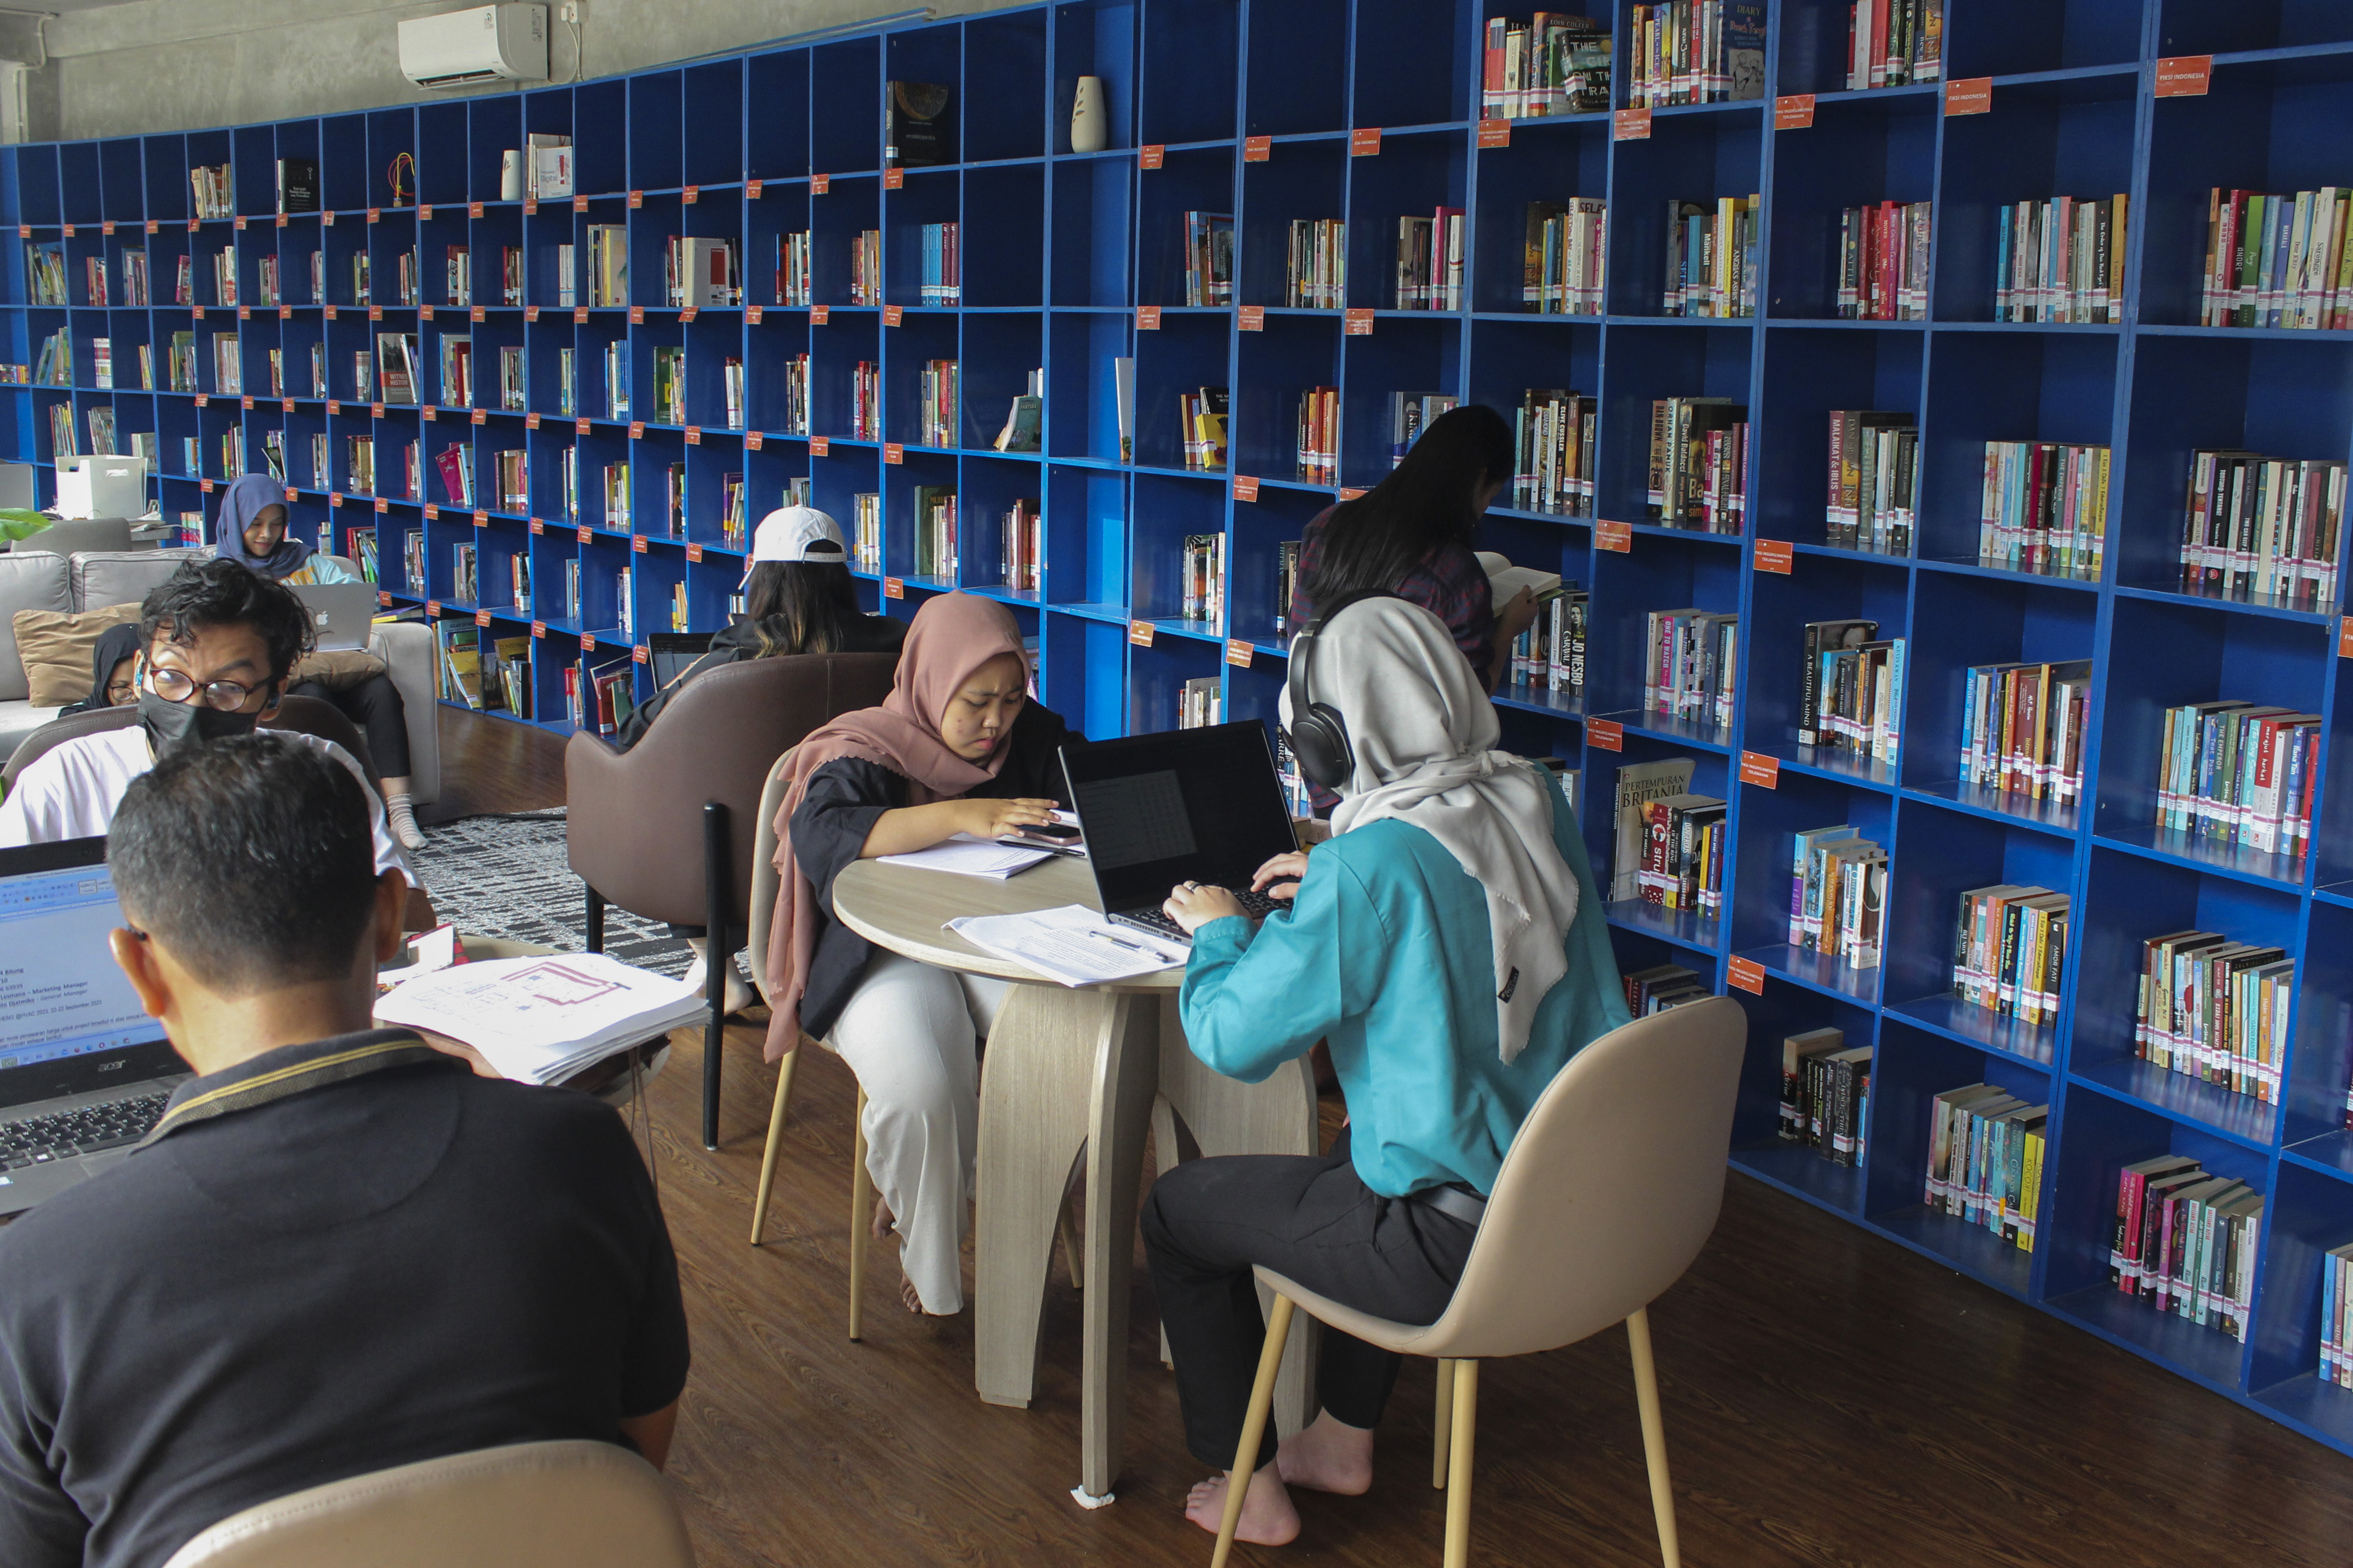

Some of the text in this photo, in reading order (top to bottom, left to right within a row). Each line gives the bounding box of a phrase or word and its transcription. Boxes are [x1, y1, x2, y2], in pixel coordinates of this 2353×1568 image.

[1737, 5, 1761, 16] DIARY
[1566, 21, 1590, 29] COLFER
[1570, 42, 1598, 51] THE
[1573, 72, 1591, 82] ON
[541, 175, 557, 184] Digital
[1703, 234, 1711, 265] Mankell
[2235, 247, 2244, 271] ANDRE
[2313, 242, 2323, 276] Sarongge
[1409, 412, 1418, 439] KING
[1654, 405, 1664, 441] DAN BROWN
[1679, 424, 1690, 473] David Baldacci
[1830, 419, 1840, 490] MALAIKAT & IBLIS
[1720, 474, 1729, 511] FINAL FLIGHT
[1843, 484, 1856, 508] INFE
[2216, 470, 2226, 516] Tentang: TENTANG!
[2273, 506, 2281, 542] PINTU
[1563, 630, 1571, 662] CARAVAL
[1572, 638, 1585, 652] JO
[1664, 636, 1670, 644] TO
[1805, 662, 1813, 702] BEAUTIFUL
[2215, 740, 2223, 770] EMPEROR
[2260, 726, 2271, 781] merajut harkat
[2292, 745, 2300, 762] Ilana
[1626, 775, 1684, 791] PERTEMPURAN
[1623, 785, 1684, 807] BRITANIA
[1683, 822, 1691, 854] DANGEROUS
[1653, 847, 1662, 873] stru
[1, 981, 88, 1000] Lesmana Marketing Manager
[9, 989, 88, 1007] Djatmiko General Manager
[65, 1002, 90, 1011] September
[98, 1060, 126, 1072] acer
[2235, 1272, 2243, 1303] brownies
